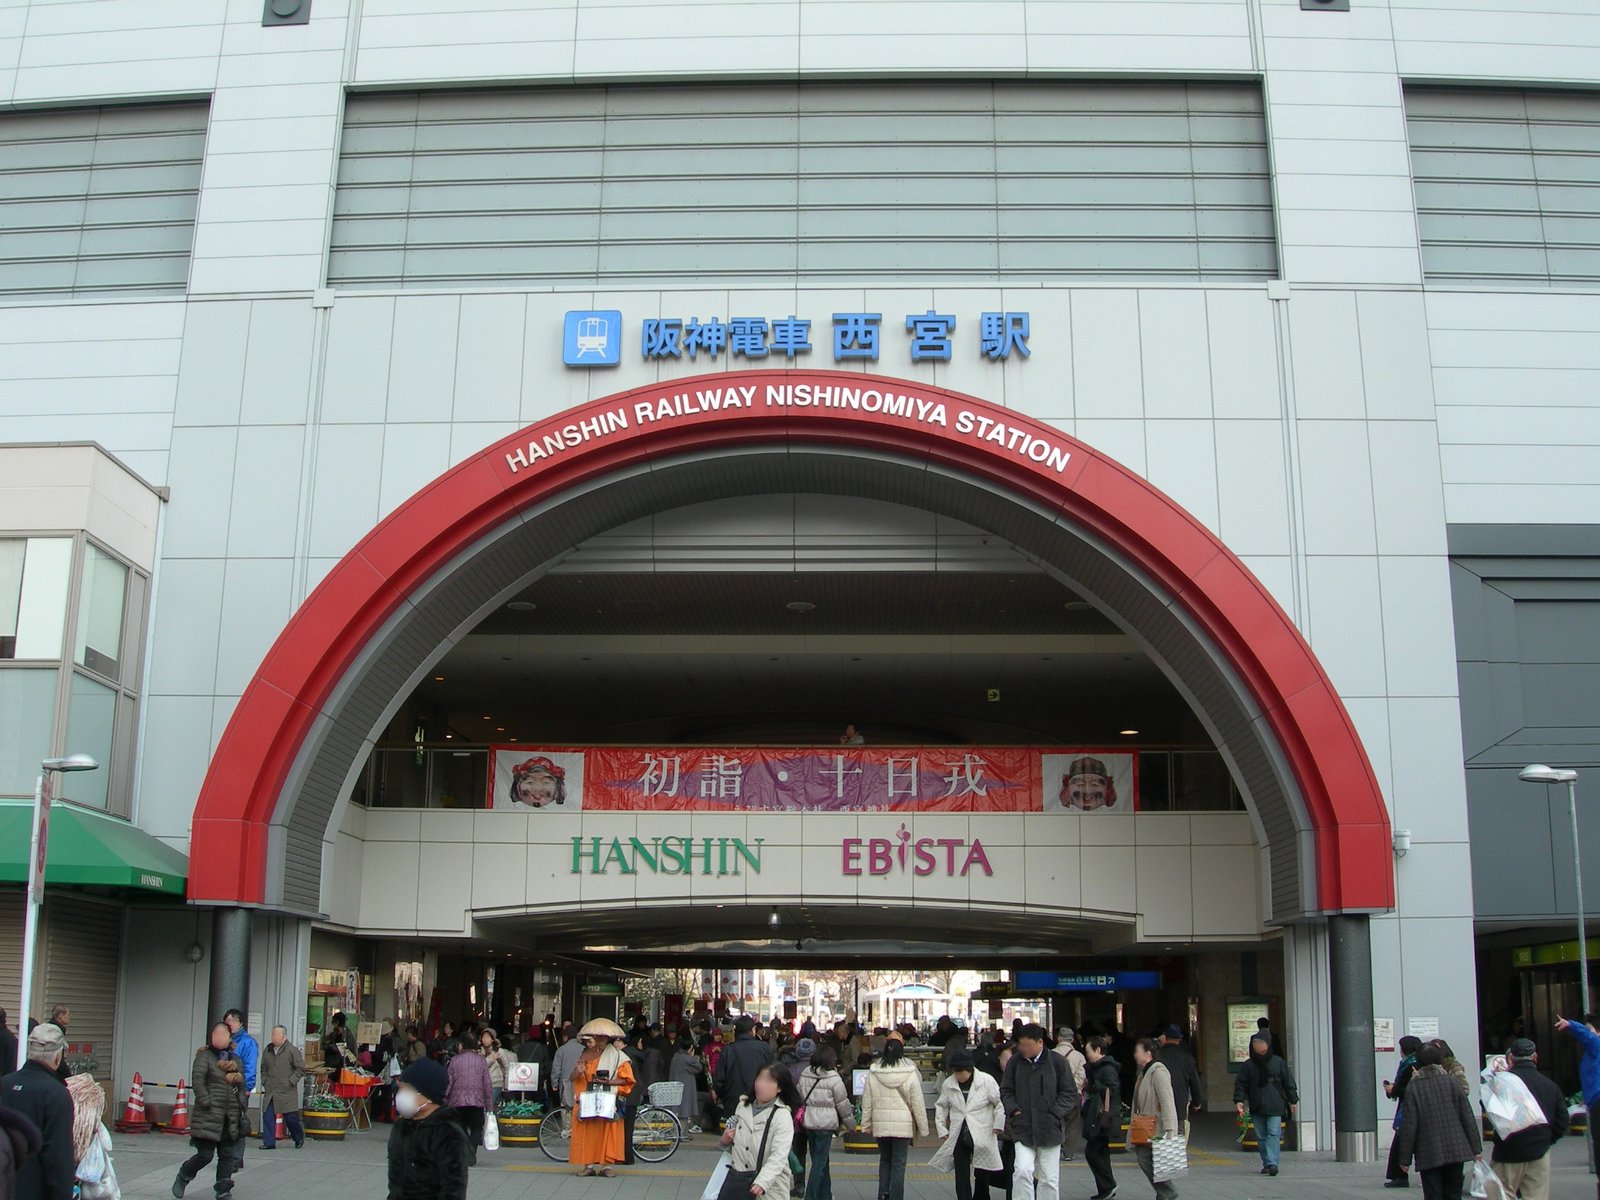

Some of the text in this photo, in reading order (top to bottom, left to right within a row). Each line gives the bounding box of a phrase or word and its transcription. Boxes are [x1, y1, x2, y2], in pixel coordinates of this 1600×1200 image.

[642, 316, 811, 360] 阪神電車
[505, 384, 1071, 473] HANSHIN RAILWAY NISHINOMIYA STATION
[571, 836, 765, 875] HANSHIN
